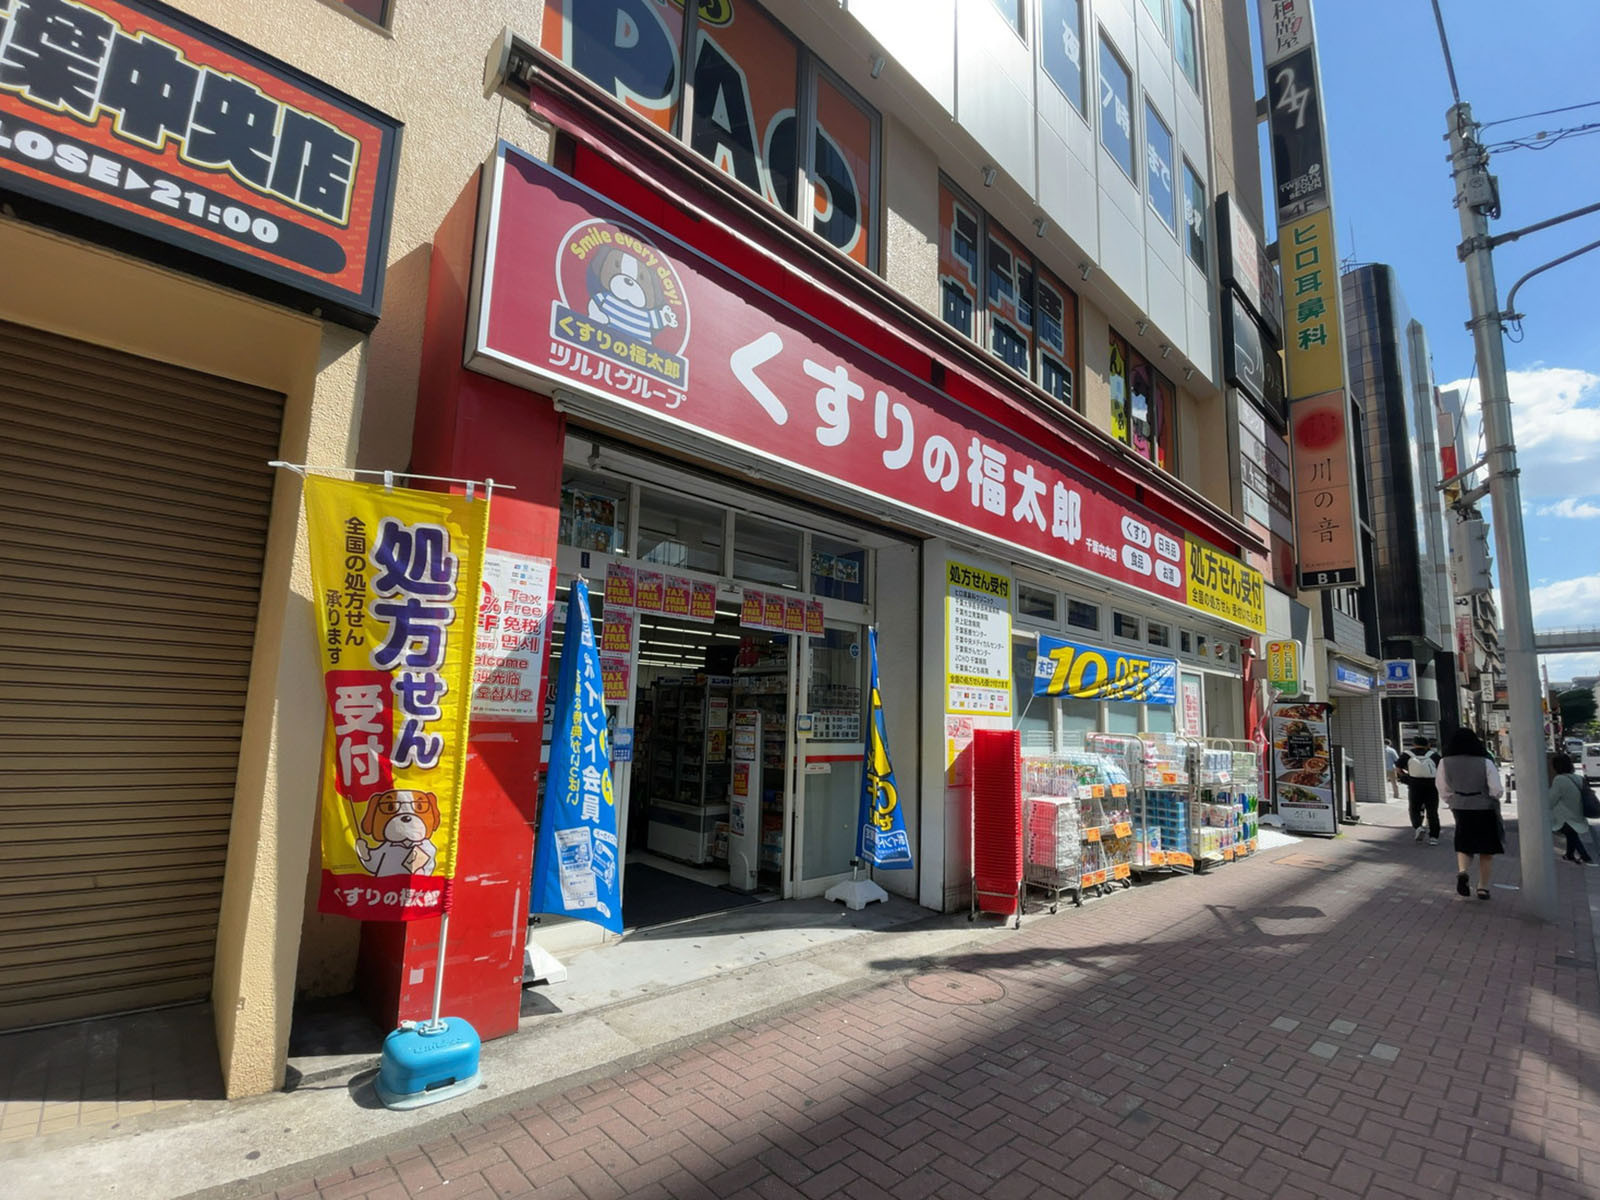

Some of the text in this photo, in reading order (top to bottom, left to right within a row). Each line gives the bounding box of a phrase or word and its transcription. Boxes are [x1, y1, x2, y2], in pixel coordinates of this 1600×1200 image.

[1289, 184, 1321, 200] SEVEN
[150, 179, 279, 244] 21:00
[570, 227, 682, 306] Smile every day!
[1294, 223, 1328, 349] ヒロ耳鼻科
[558, 316, 681, 379] くすりの福太郎
[549, 343, 687, 409] ツルハグループ
[730, 332, 1081, 545] くすりの福太郎
[1310, 458, 1340, 543] 川の音
[1126, 522, 1147, 543] くすり
[345, 517, 367, 646] 全国の処方せん
[608, 578, 627, 586] TAX
[949, 565, 1008, 597] 処方せん受付
[1190, 541, 1262, 611] 処方せん受付
[1318, 572, 1340, 584] B1
[608, 587, 630, 596] FREE
[638, 583, 656, 591] TAX
[638, 592, 658, 600] FREE
[667, 588, 684, 597] TAX
[693, 592, 710, 600] TAX
[509, 589, 541, 605] Tax
[692, 601, 711, 609] FREE
[503, 601, 543, 618] Free
[326, 589, 342, 664] 承ります
[503, 616, 540, 634] 免税
[605, 623, 624, 633] TAX
[371, 519, 456, 767] 処方せん
[501, 634, 540, 653] 면세
[605, 634, 626, 642] FREE
[472, 669, 521, 686] 迎光临
[603, 690, 626, 698] TORE
[335, 685, 384, 787] 受付
[334, 887, 441, 907] くすりの福太郎
